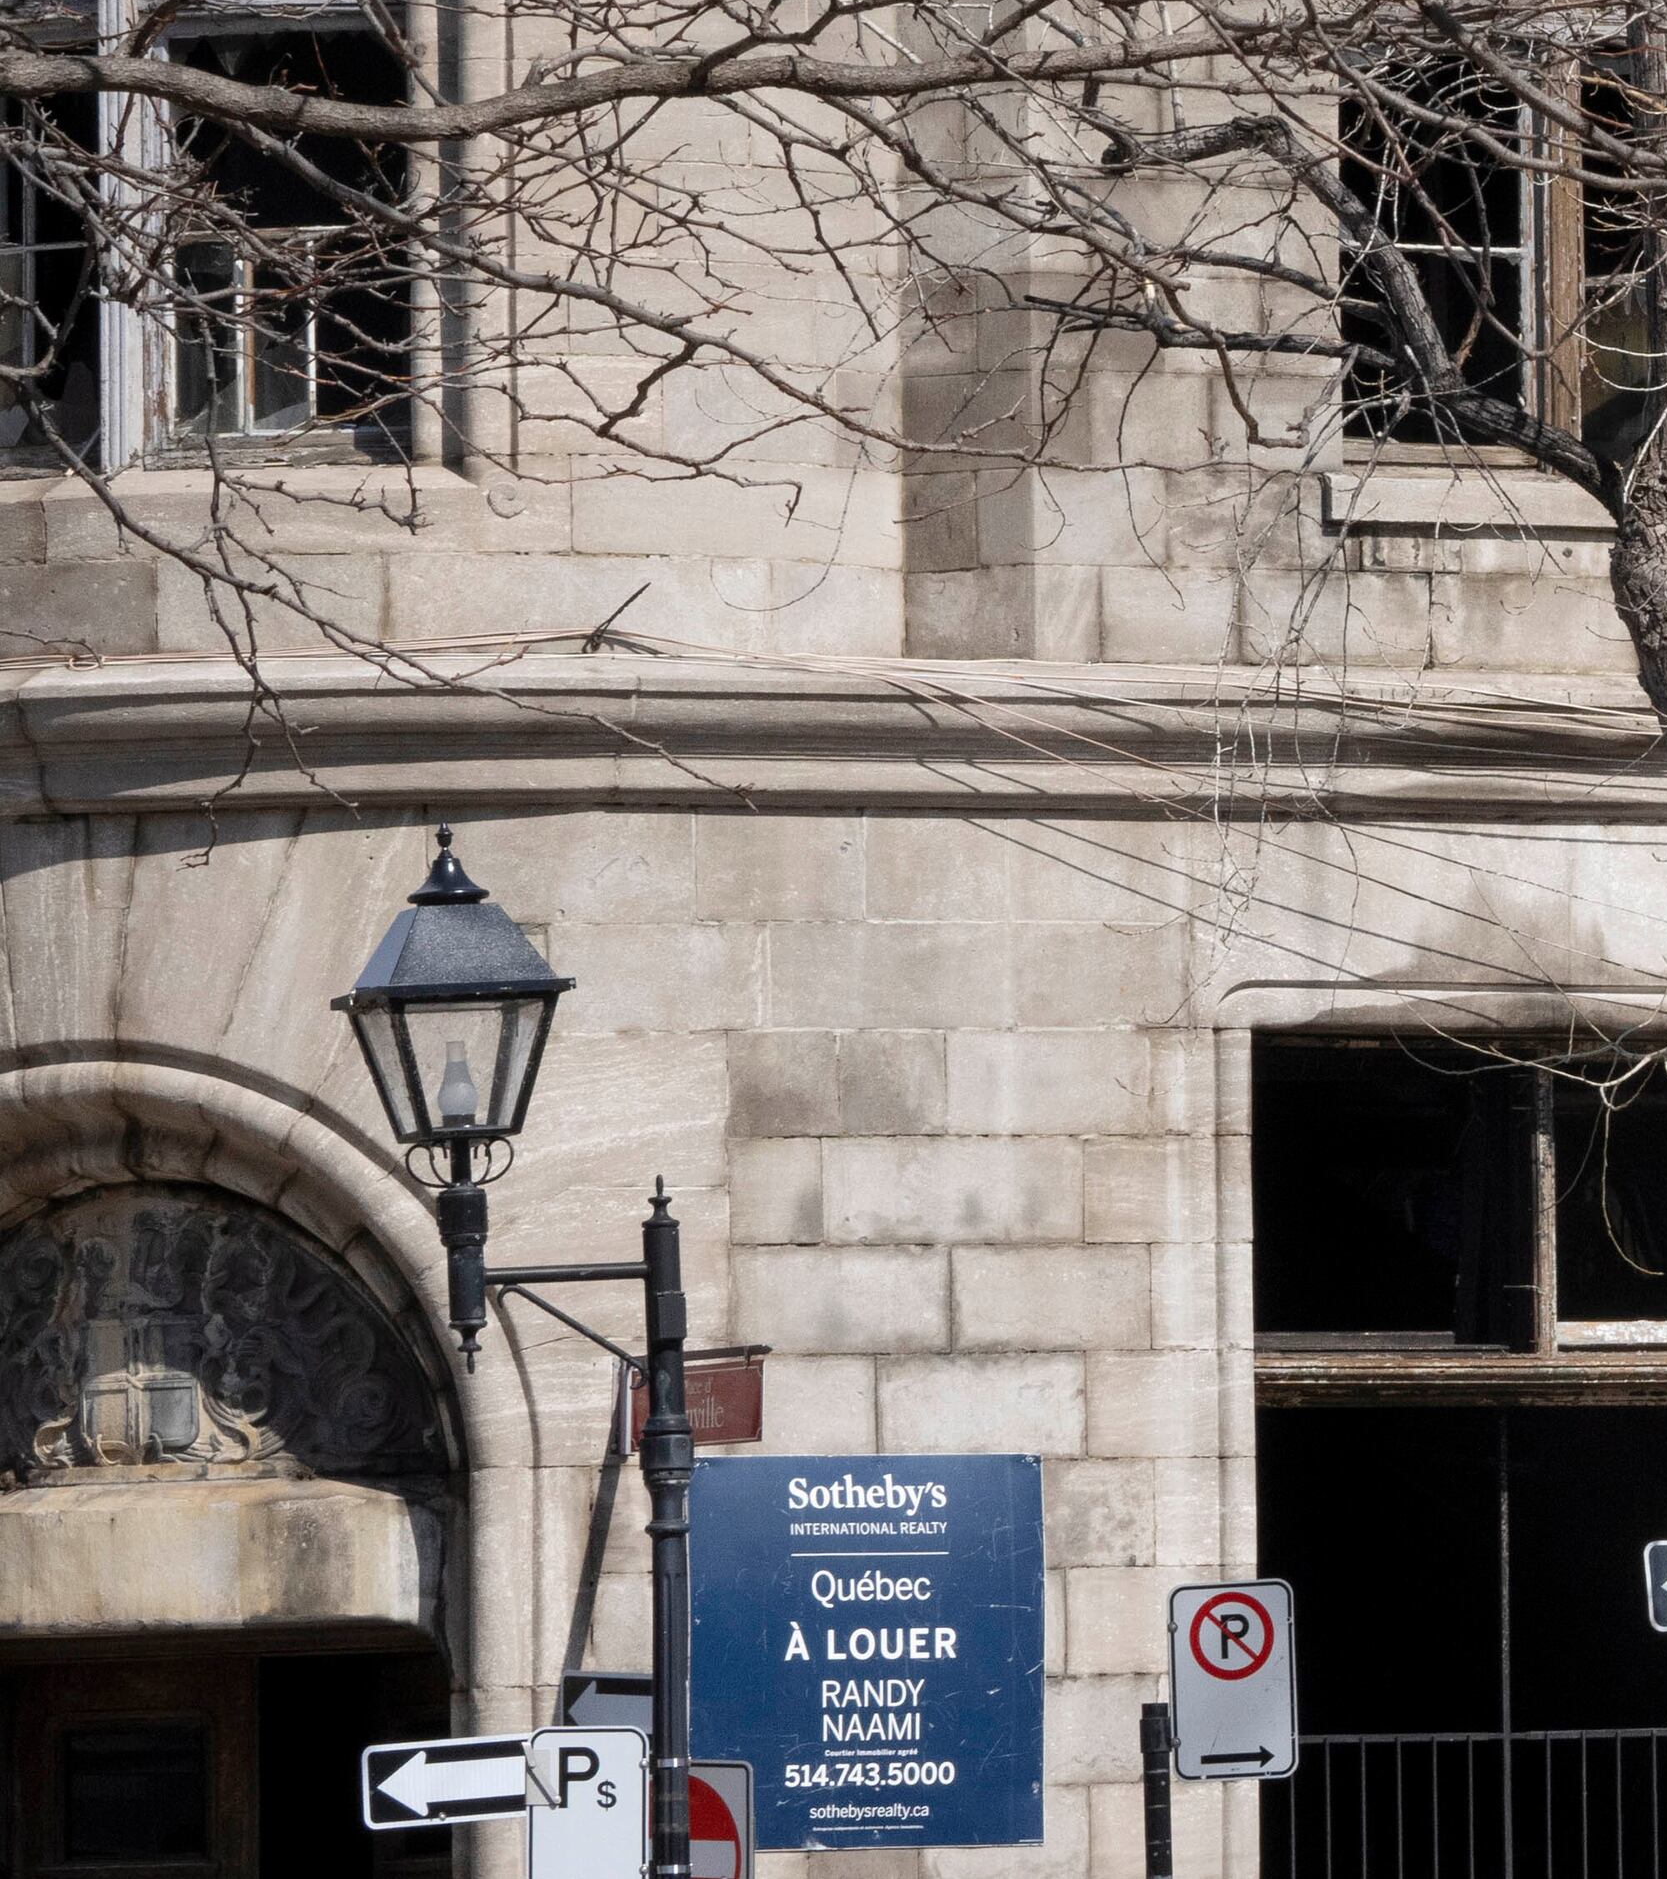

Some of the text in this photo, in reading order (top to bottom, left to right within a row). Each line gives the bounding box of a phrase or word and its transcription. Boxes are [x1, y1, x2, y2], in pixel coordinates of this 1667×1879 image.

[788, 1474, 947, 1515] Sotheby's
[790, 1521, 948, 1536] INTERNATIONAL REALTY
[811, 1570, 932, 1608] Québec
[784, 1622, 957, 1661] À LOUER
[822, 1679, 925, 1708] RANDY
[822, 1712, 921, 1742] NAAMI
[784, 1762, 956, 1788] 514.743.5000
[809, 1803, 930, 1822] sothebysrealty.ca
